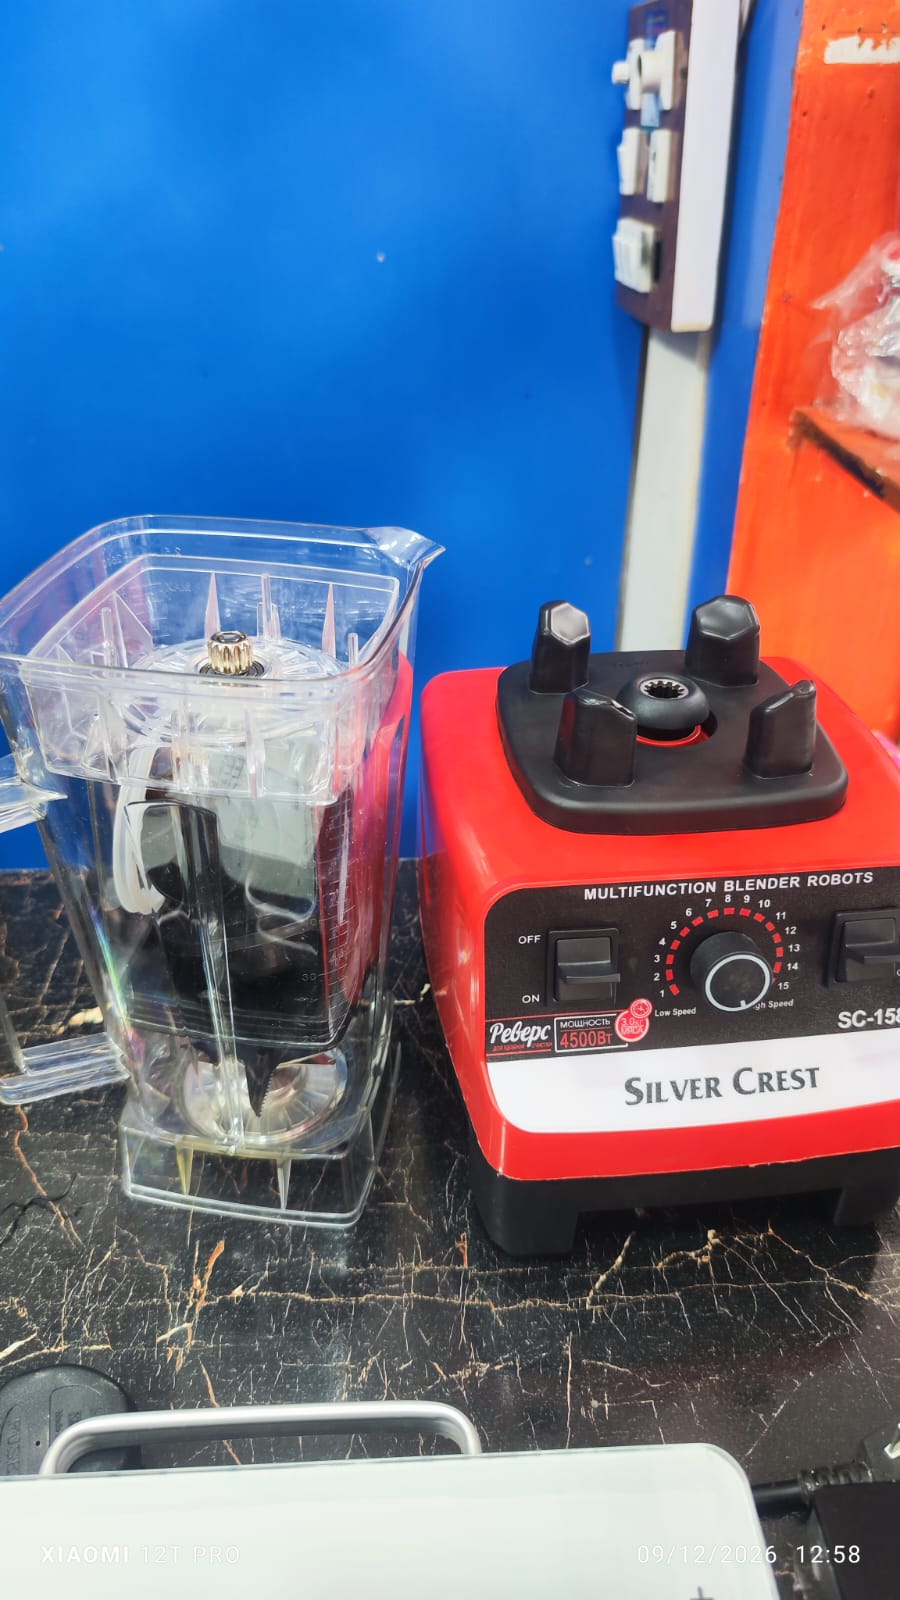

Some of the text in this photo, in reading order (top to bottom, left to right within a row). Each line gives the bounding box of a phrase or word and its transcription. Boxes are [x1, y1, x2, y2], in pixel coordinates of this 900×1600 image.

[583, 871, 874, 900] MULTIFUNCTION BLENDER ROBOTS
[705, 898, 712, 907] 7
[724, 894, 731, 903] 8
[743, 894, 750, 903] 9
[758, 899, 771, 908] 10
[685, 908, 692, 917] 6
[775, 911, 786, 920] 11
[670, 921, 677, 930] 5
[784, 926, 797, 935] 12
[518, 934, 541, 945] OFF
[658, 937, 666, 946] 4
[788, 944, 800, 952] 13
[654, 955, 660, 963] 3
[786, 962, 799, 971] 14
[653, 972, 660, 981] 2
[778, 981, 789, 990] 15
[521, 994, 540, 1004] ON
[752, 998, 794, 1011] gh Speed
[654, 1006, 697, 1017] Low Speed
[559, 1019, 611, 1029] МОЩНОСТЬ
[489, 1020, 552, 1048] Реверс
[624, 1066, 820, 1106] SILVER CREST
